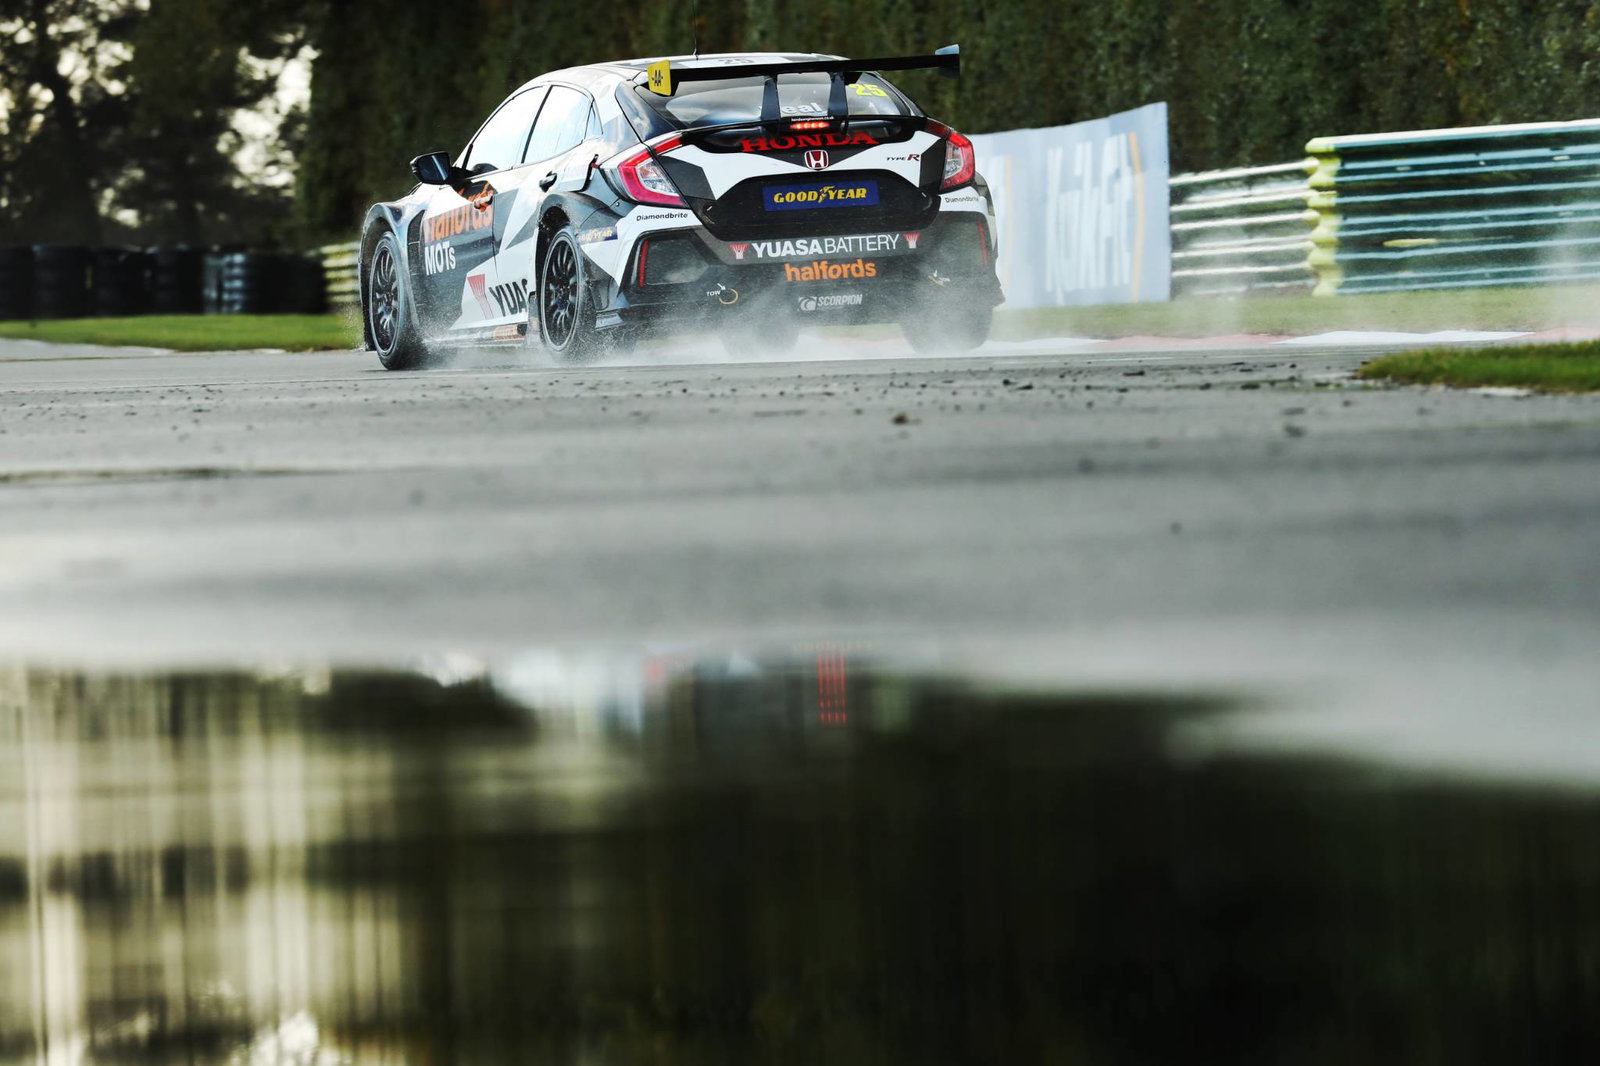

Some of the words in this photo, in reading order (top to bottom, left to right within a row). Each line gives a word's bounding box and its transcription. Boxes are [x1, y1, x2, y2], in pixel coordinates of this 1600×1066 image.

[848, 83, 888, 97] 25
[758, 102, 823, 114] eal
[739, 131, 880, 153] HONDA
[907, 153, 920, 162] R
[636, 212, 688, 222] Diamondbrite
[752, 239, 823, 258] YUASA
[824, 233, 900, 254] BATTERY
[424, 241, 456, 276] MOTs
[784, 258, 878, 282] halfords
[817, 294, 863, 307] SCORPION
